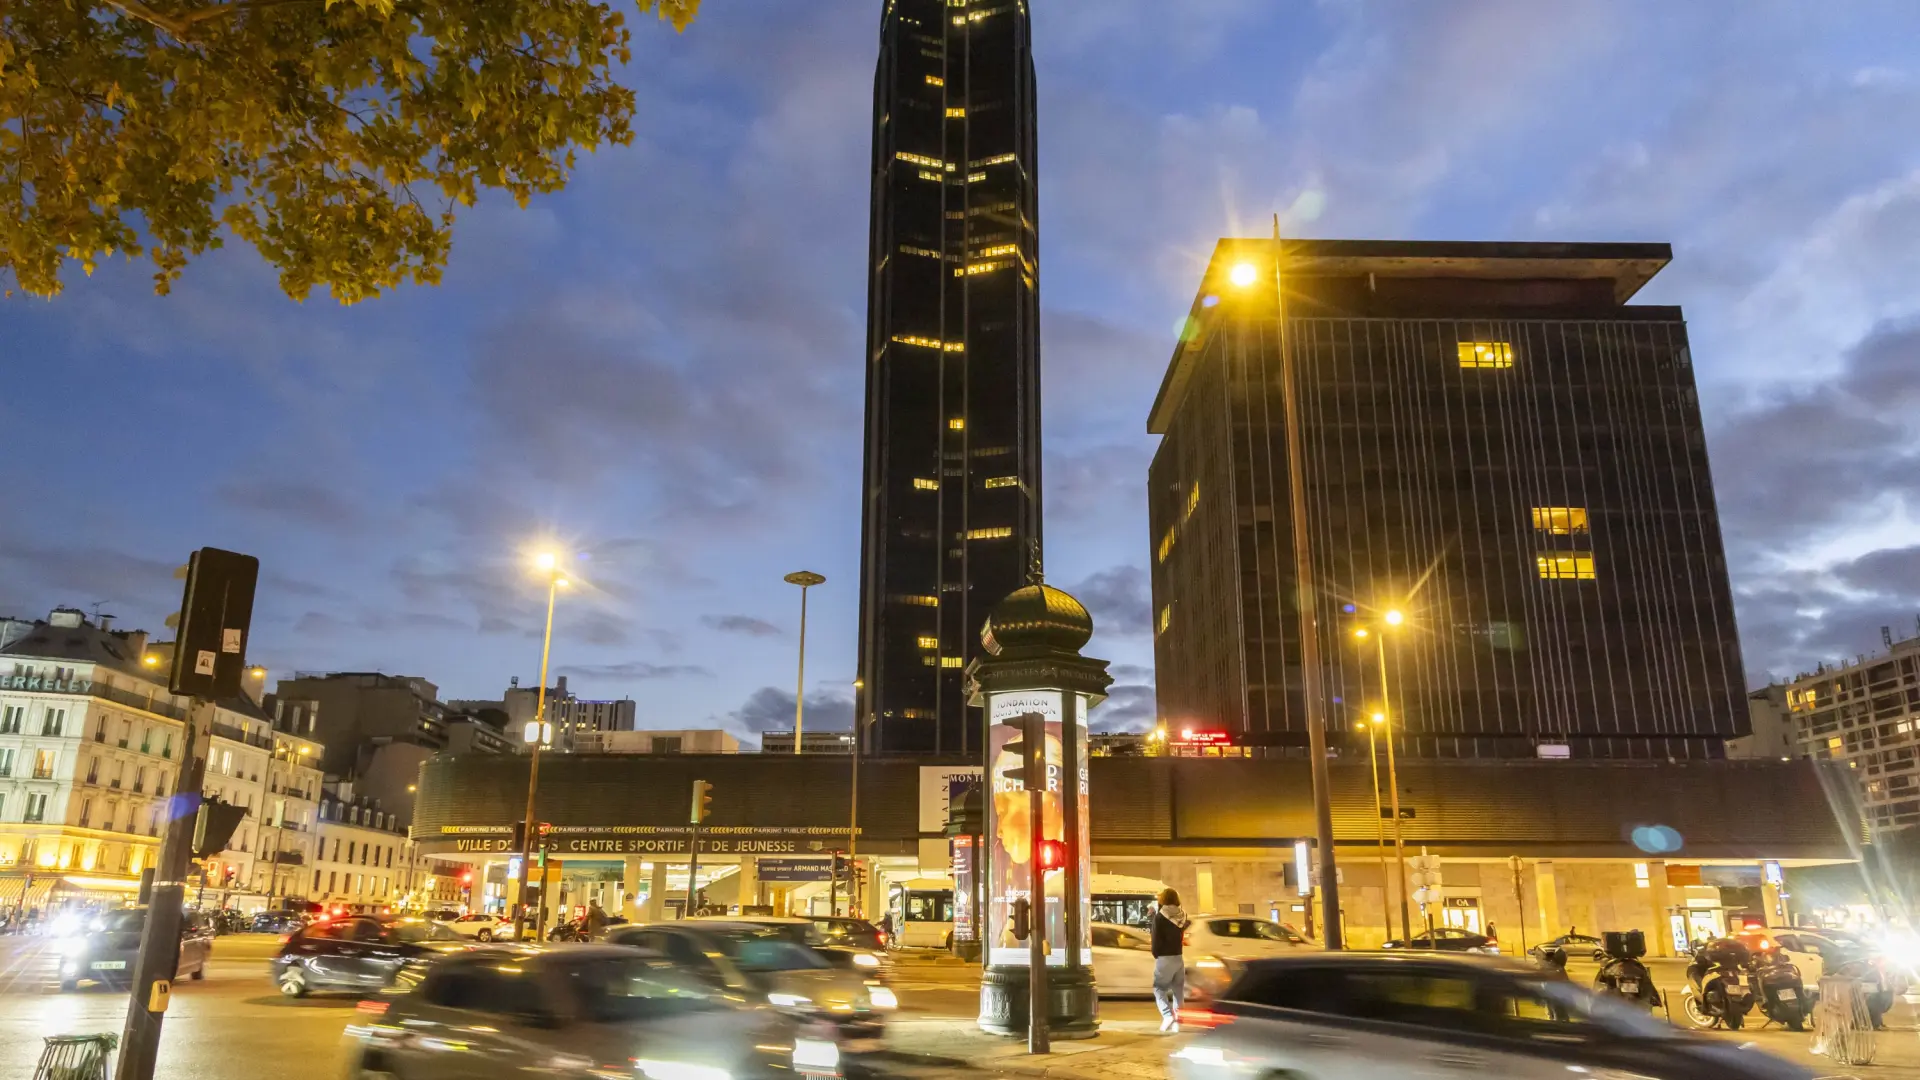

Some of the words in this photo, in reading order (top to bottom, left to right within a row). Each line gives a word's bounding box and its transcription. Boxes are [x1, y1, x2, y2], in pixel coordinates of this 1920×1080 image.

[993, 778, 1058, 792] RICHR
[457, 840, 491, 851] VILLE
[570, 840, 623, 851] CENTRE
[629, 840, 685, 851] SPORTIF
[711, 840, 729, 851] DE
[734, 840, 795, 851] JEUNESSE
